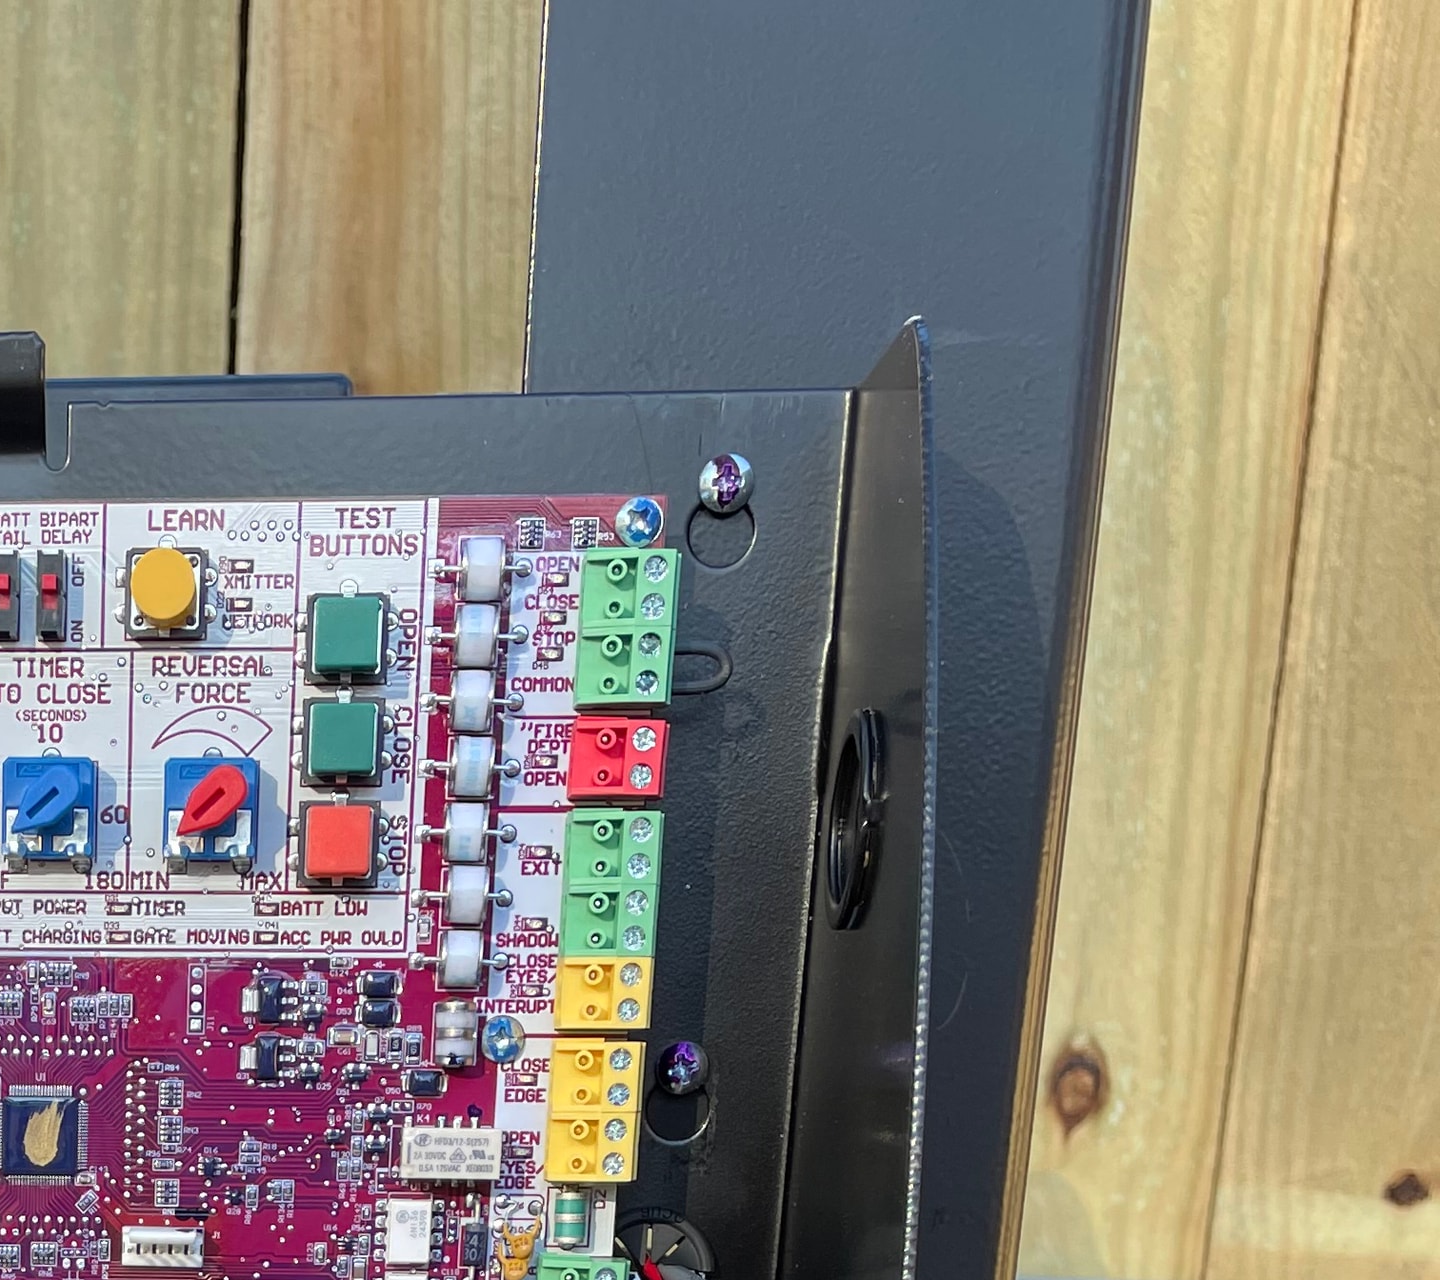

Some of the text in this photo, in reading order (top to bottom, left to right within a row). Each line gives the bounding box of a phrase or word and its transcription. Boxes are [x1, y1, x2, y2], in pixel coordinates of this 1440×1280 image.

[39, 511, 99, 528] BIPART
[147, 509, 225, 531] LEARN
[335, 507, 396, 529] TEST
[40, 529, 93, 545] DELAY
[310, 534, 418, 557] BUTTONS
[70, 552, 85, 587] OFF
[533, 556, 580, 572] OPEN
[224, 574, 295, 590] XMITTER
[524, 594, 579, 611] CLOSE
[222, 613, 294, 629] NETWORK
[70, 619, 83, 643] ON
[532, 631, 576, 647] STOP
[398, 608, 417, 672] OPEN
[13, 657, 84, 679] TIMER
[151, 656, 273, 677] REVERSAL
[511, 677, 575, 692] COMMON
[36, 683, 111, 704] CLOSE
[175, 682, 251, 704] FORCE
[15, 709, 87, 723] (SECONDS)
[36, 723, 64, 744] 10
[391, 706, 414, 784] CLOSE
[527, 739, 570, 754] DEPT
[523, 771, 566, 786] OPEN
[100, 805, 129, 825] 60
[389, 815, 408, 876] STOP
[521, 861, 561, 876] EXIT
[85, 871, 125, 890] 180
[130, 871, 170, 890] MIN
[241, 871, 283, 890] MAX
[33, 901, 87, 915] POWER
[134, 901, 186, 915] TIMER
[281, 901, 368, 916] BATT LOW
[22, 930, 102, 945] CHARGING
[133, 930, 250, 945] GATE MOVING
[280, 931, 403, 946] ACC PWR OVLD
[496, 933, 559, 948] SHADOW
[505, 954, 557, 969] CLOSE
[476, 999, 555, 1014] INTERUPT
[501, 1058, 550, 1073] CLOSE
[504, 1089, 546, 1103] EDGE
[494, 1176, 536, 1190] EDGE
